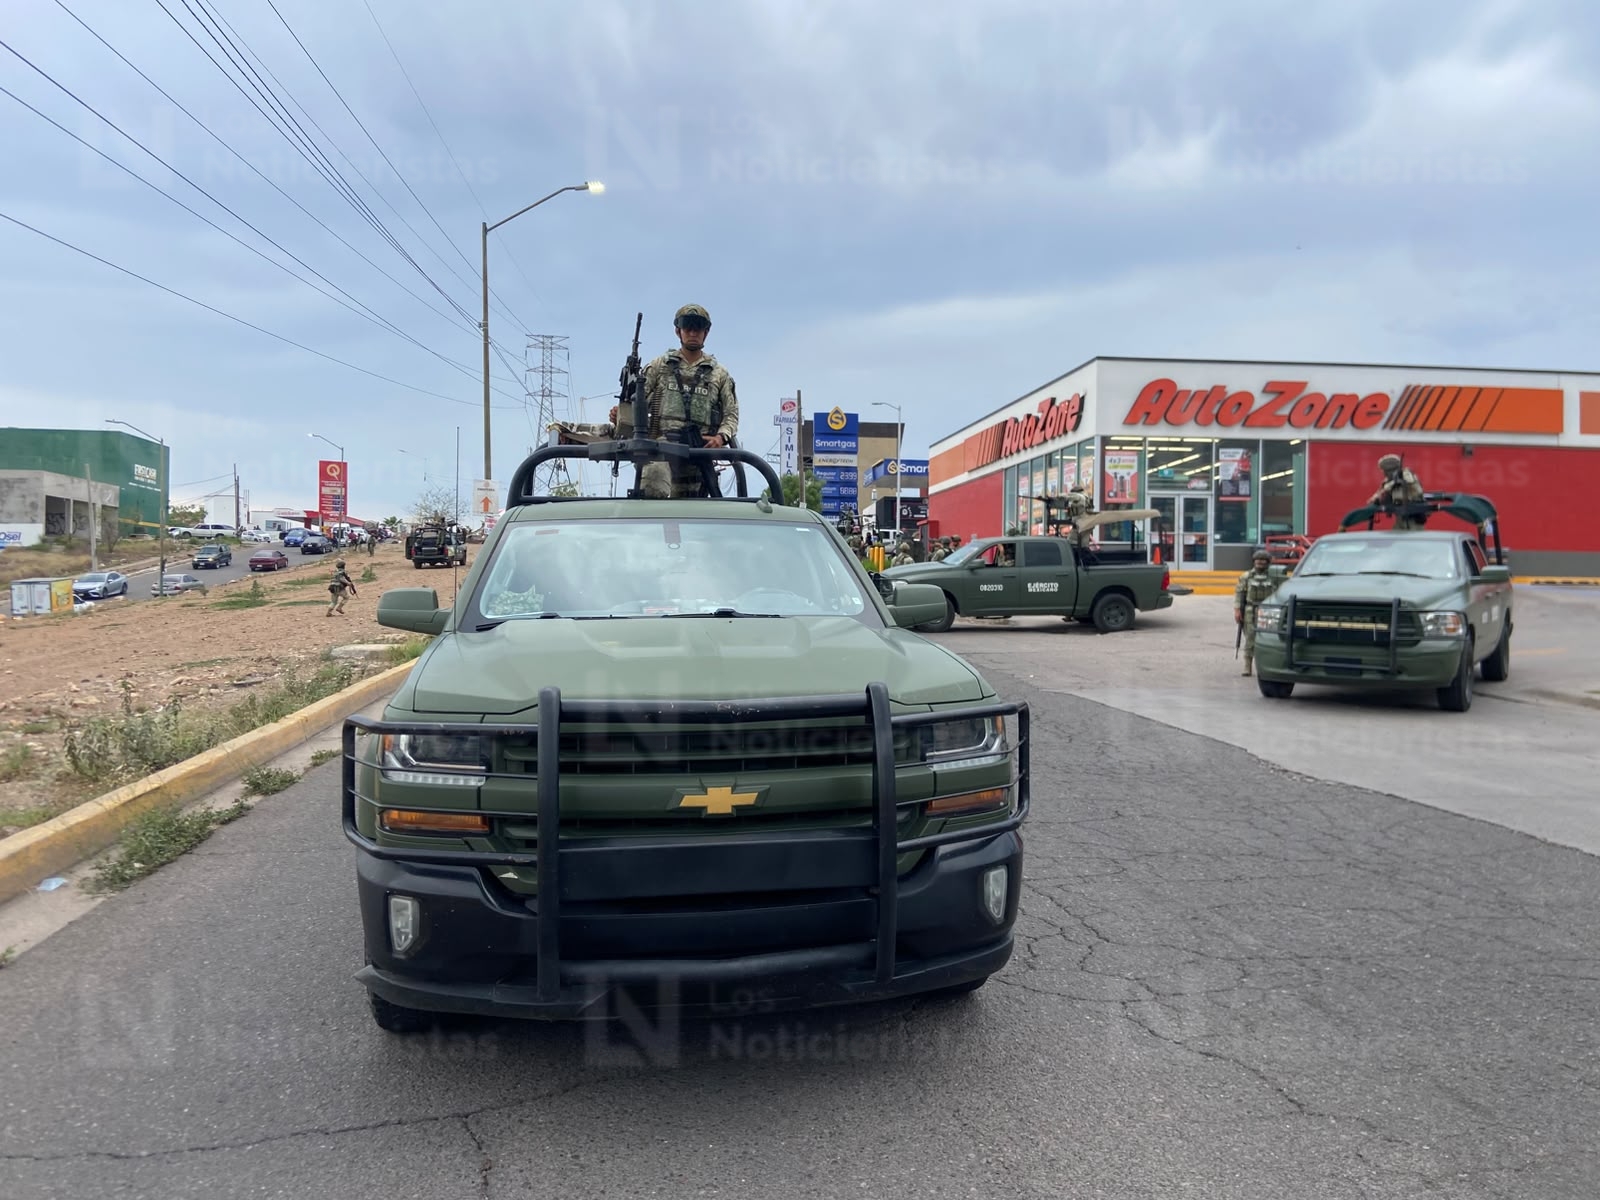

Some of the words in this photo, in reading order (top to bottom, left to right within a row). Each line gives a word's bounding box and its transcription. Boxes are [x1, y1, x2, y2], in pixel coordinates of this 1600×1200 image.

[1123, 378, 1392, 430] AutoZone
[1001, 393, 1082, 458] AutoZone
[815, 440, 857, 448] Smartgas
[326, 464, 341, 481] Q
